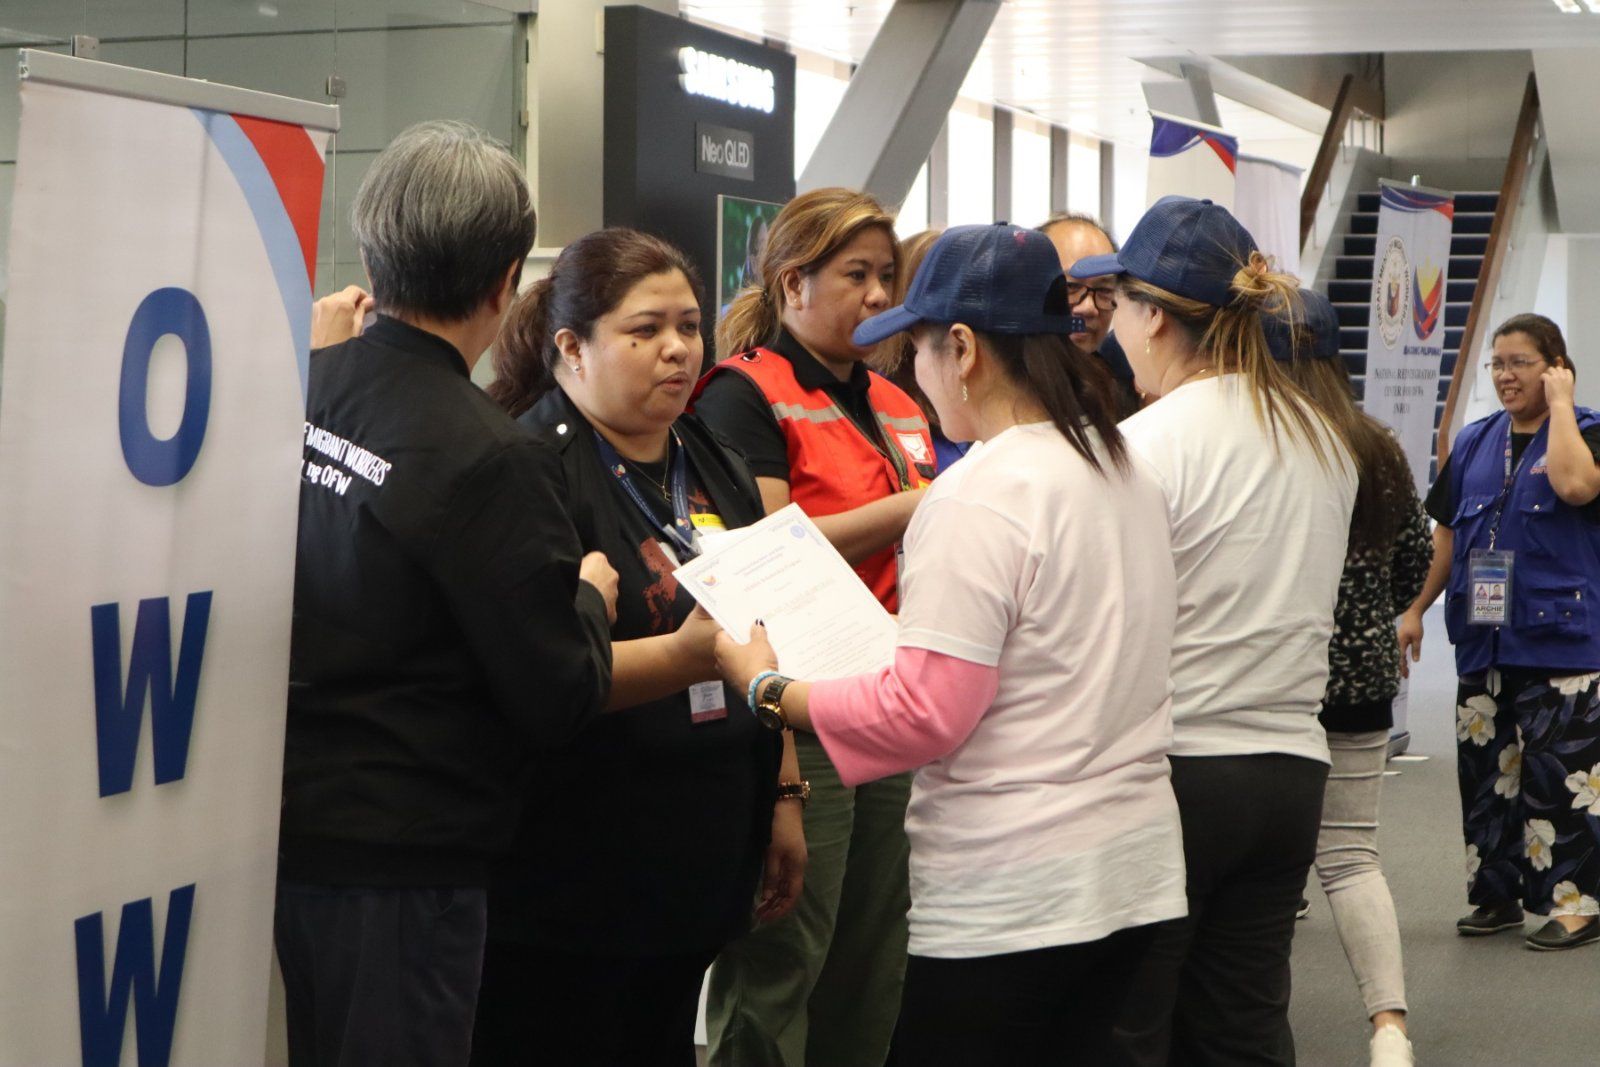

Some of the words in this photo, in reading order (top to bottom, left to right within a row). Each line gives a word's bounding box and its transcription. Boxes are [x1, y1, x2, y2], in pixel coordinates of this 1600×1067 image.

[678, 46, 774, 113] SAMSUNG
[702, 134, 723, 164] Neo
[725, 139, 750, 168] QLED
[306, 424, 350, 462] MIGRANT
[343, 442, 392, 486] WORKERS
[306, 461, 322, 484] ng
[321, 464, 353, 496] OFW
